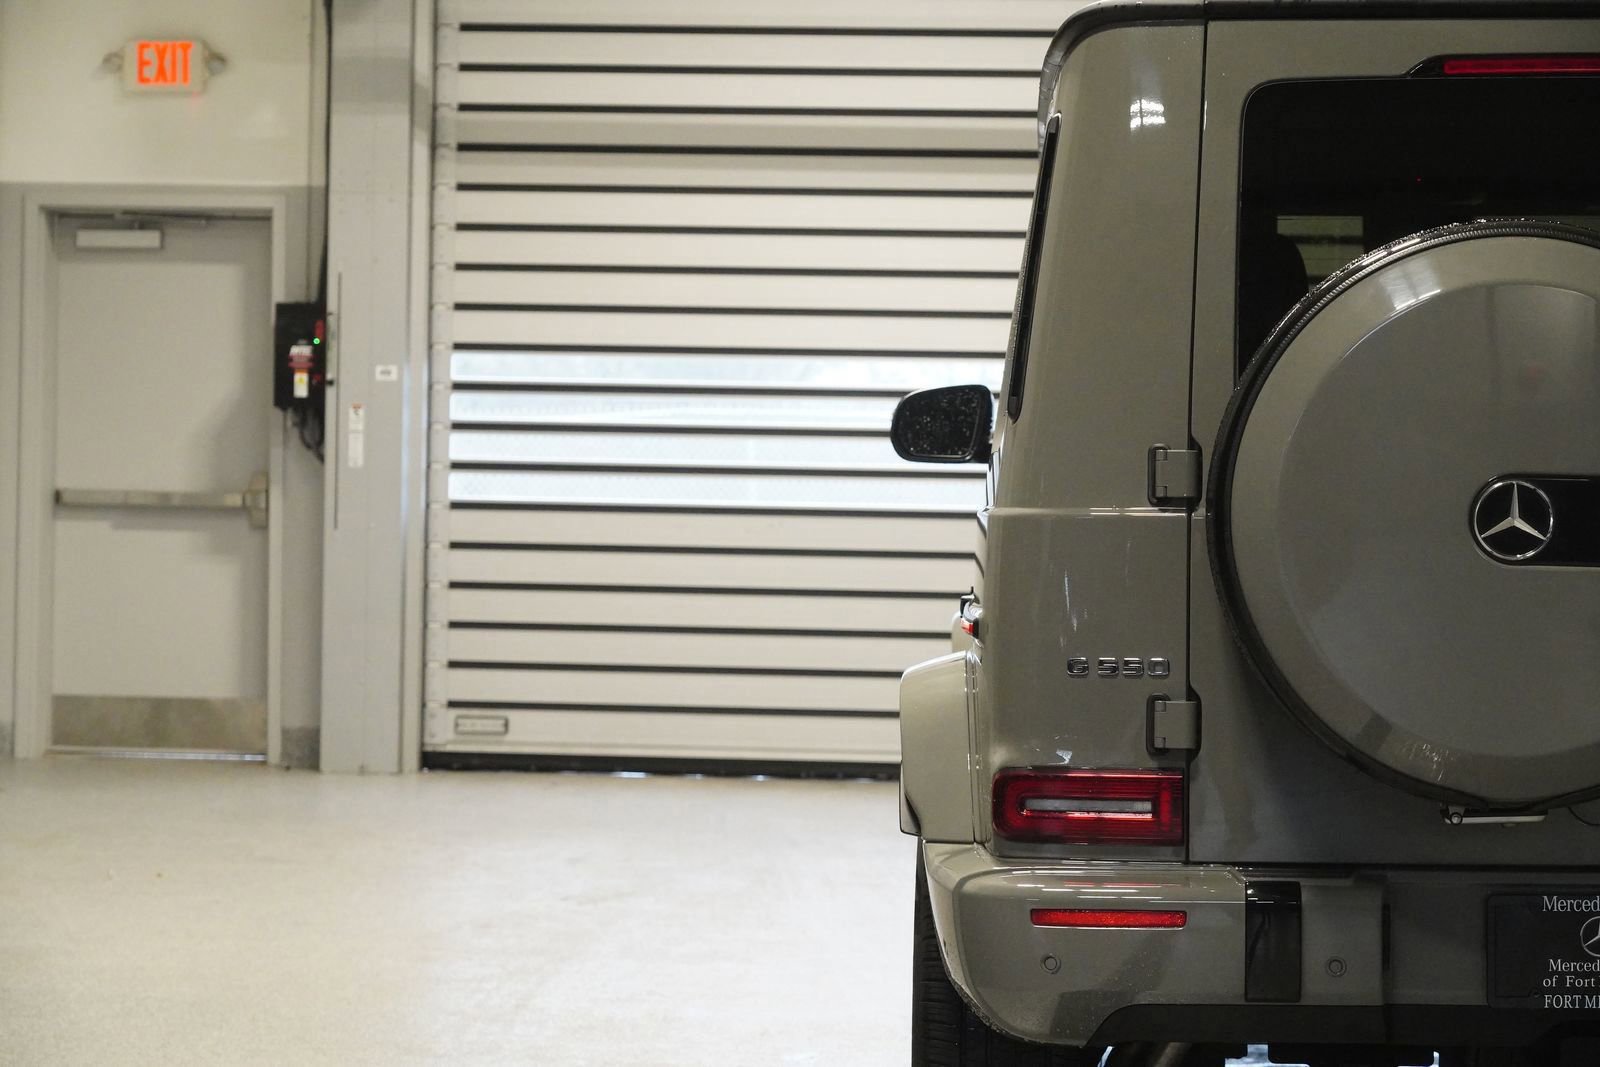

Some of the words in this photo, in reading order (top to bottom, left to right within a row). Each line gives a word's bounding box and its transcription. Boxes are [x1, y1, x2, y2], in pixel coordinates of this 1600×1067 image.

[137, 41, 193, 84] EXIT
[1067, 657, 1089, 676] G
[1098, 657, 1170, 677] 550
[1542, 895, 1600, 912] Merced
[1543, 975, 1558, 987] of
[1566, 975, 1596, 987] Fort
[1544, 995, 1581, 1009] FORT
